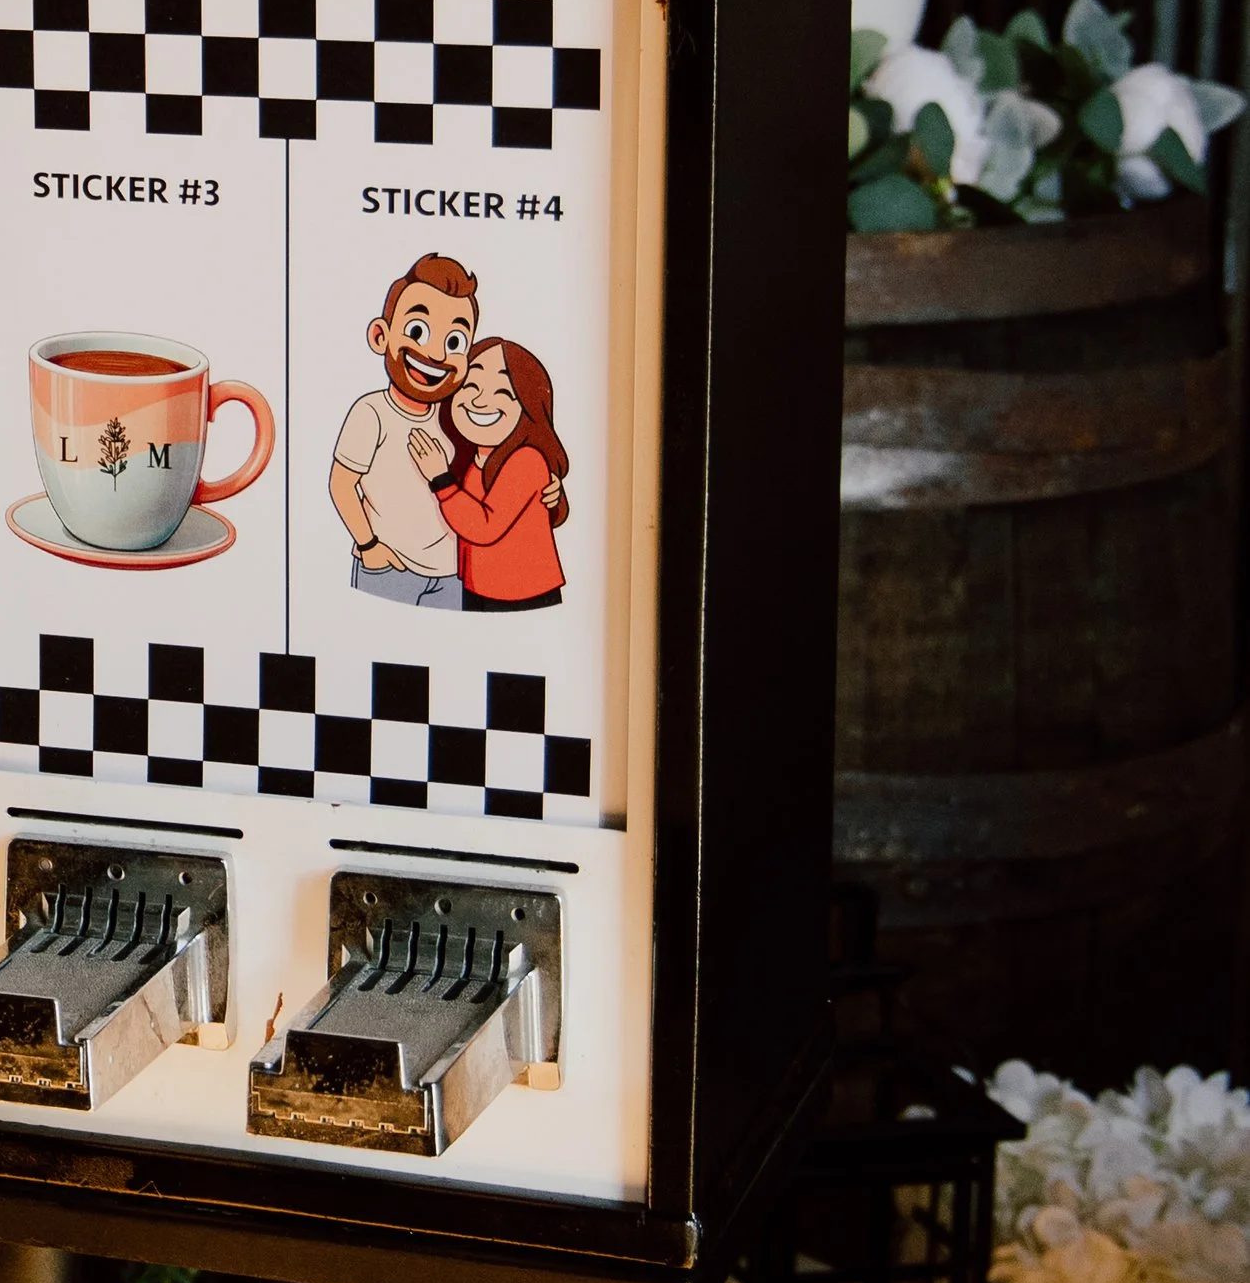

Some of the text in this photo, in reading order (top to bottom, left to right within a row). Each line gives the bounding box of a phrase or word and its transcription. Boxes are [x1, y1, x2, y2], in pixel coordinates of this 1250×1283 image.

[33, 171, 221, 207] STICKER #3
[362, 186, 564, 222] STICKER #4
[59, 436, 173, 470] L M
